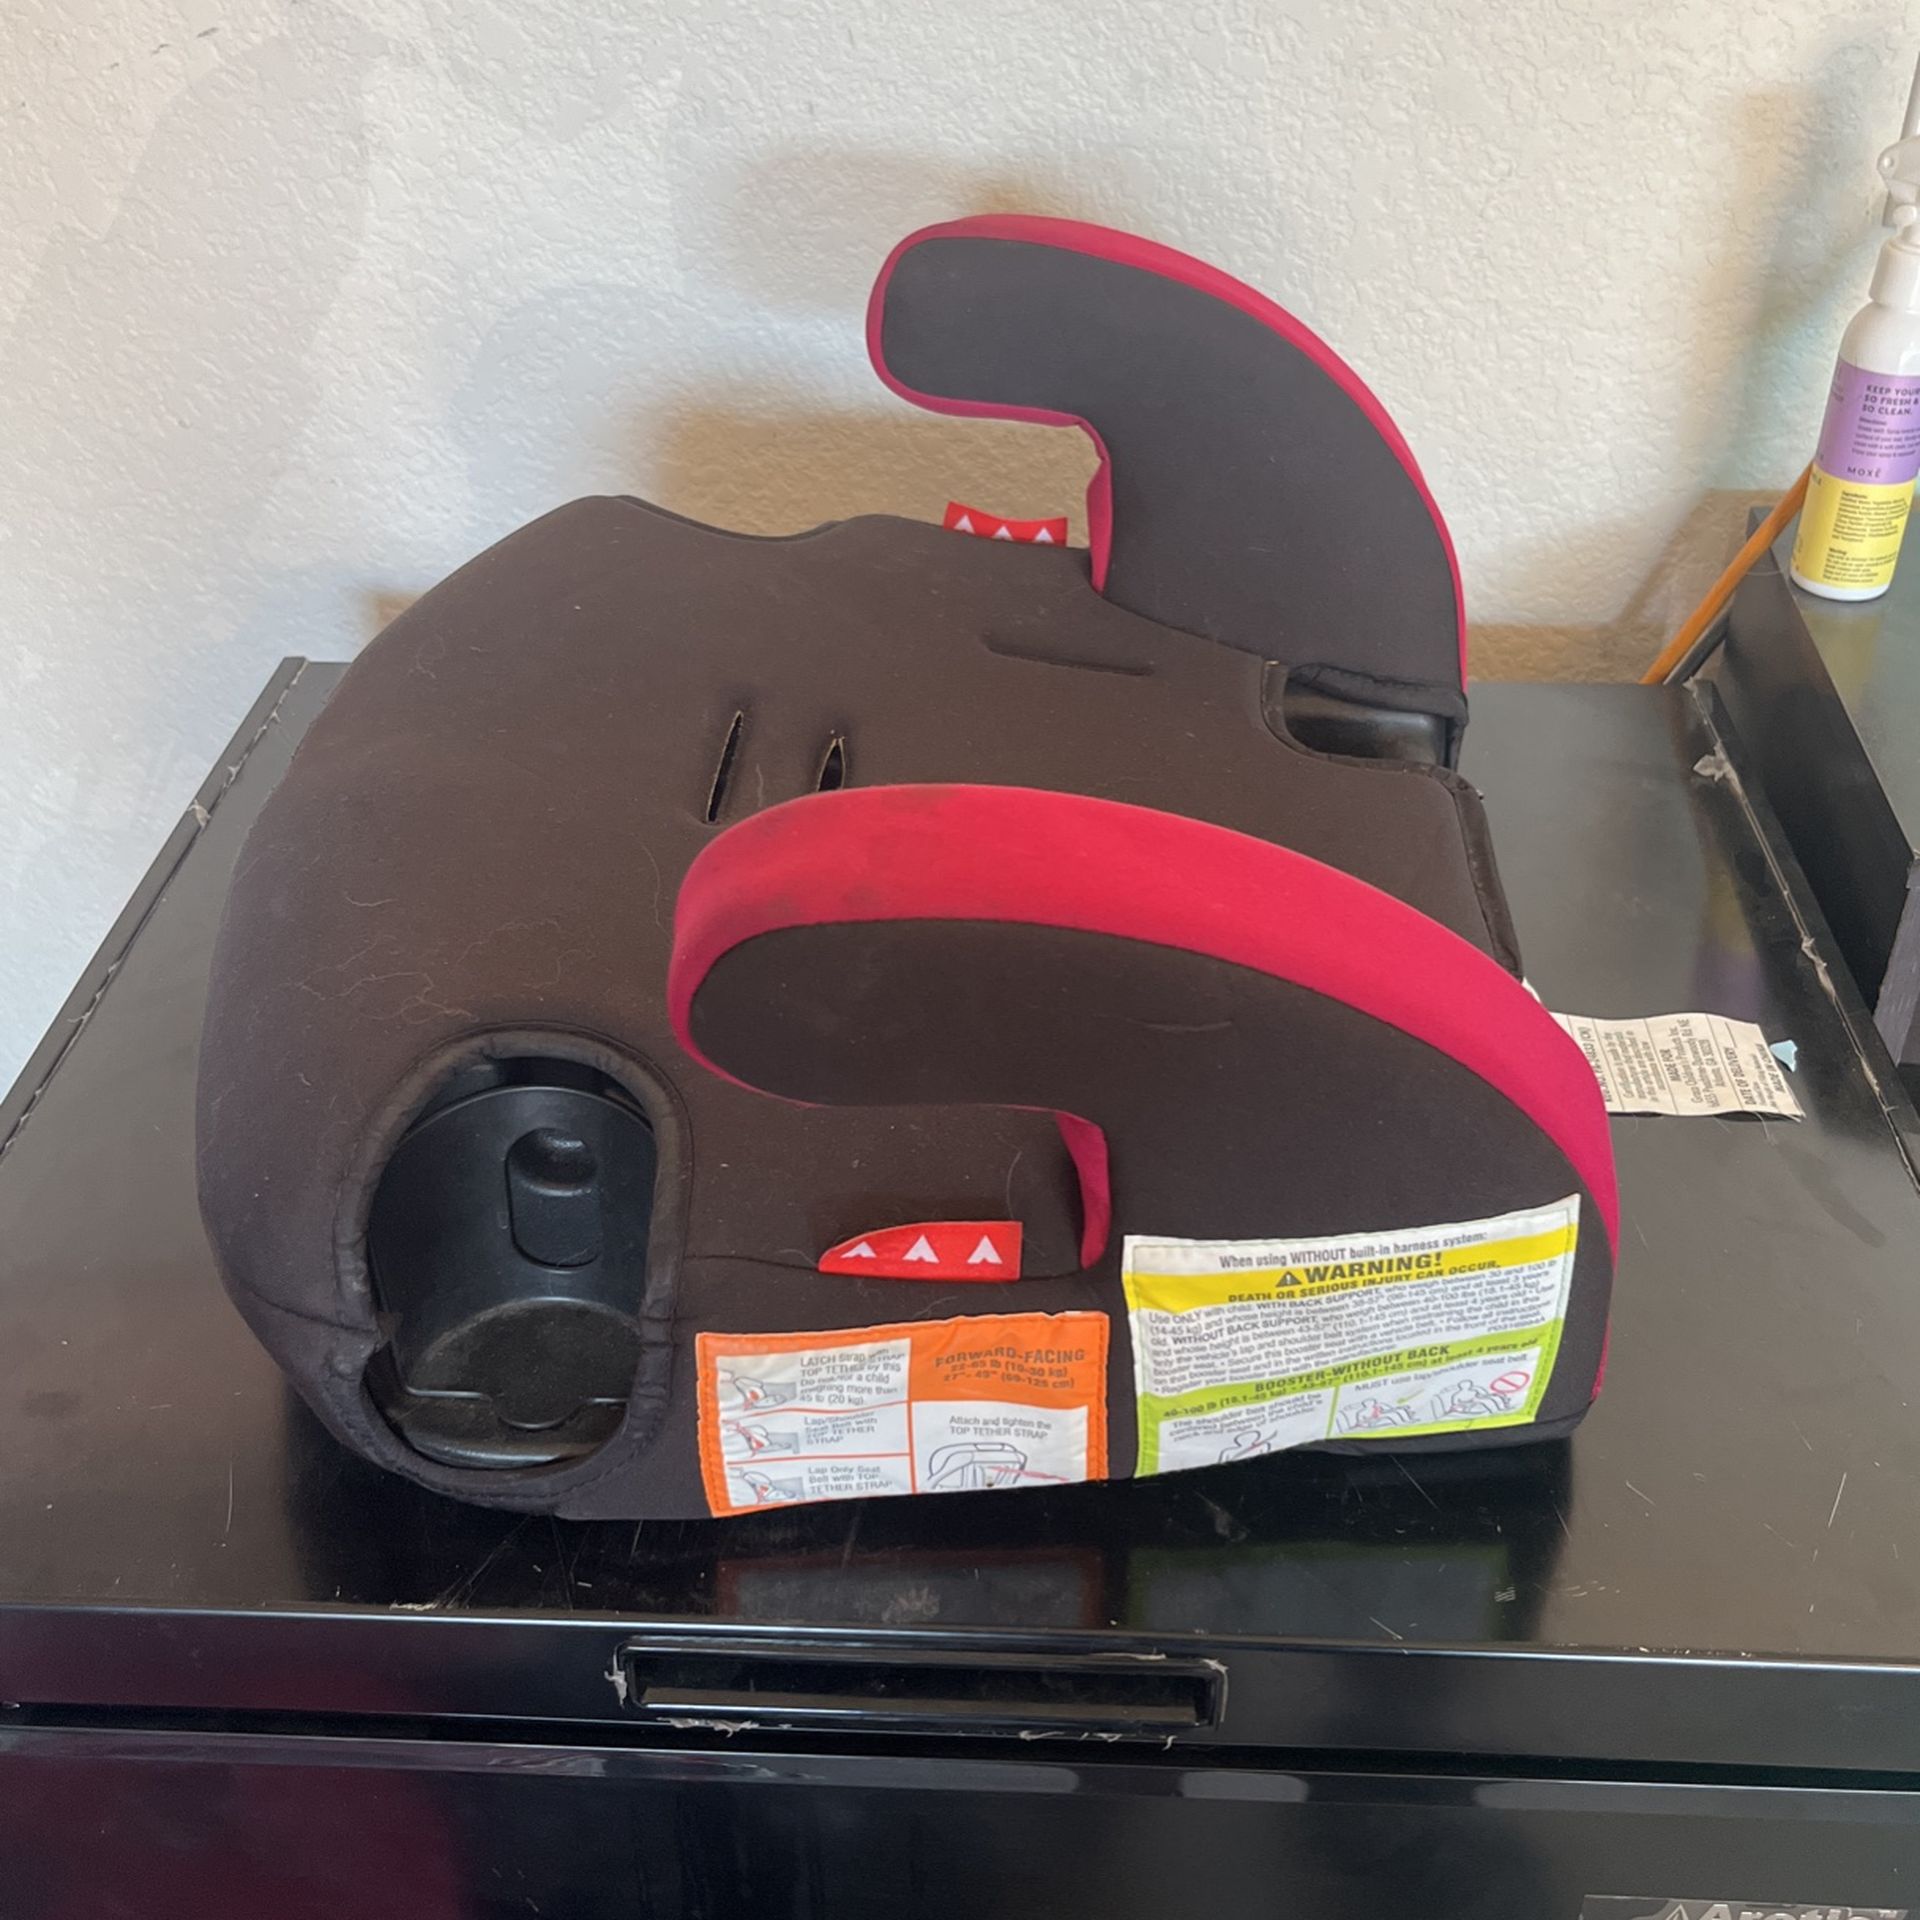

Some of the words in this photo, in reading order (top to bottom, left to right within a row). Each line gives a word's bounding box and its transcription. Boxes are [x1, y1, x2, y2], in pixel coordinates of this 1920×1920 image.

[1866, 384, 1891, 394] KEEP
[1865, 394, 1877, 404] SO
[1880, 397, 1911, 406] FRESH
[1862, 404, 1875, 413] SO
[1878, 407, 1913, 415] CLEAN.
[1659, 1049, 1674, 1062] FOR
[1724, 1047, 1744, 1078] DELIVERY
[1664, 1063, 1681, 1082] MADE
[1735, 1079, 1749, 1088] OF
[1740, 1089, 1756, 1105] DATE
[1219, 1255, 1252, 1268] When
[1256, 1254, 1287, 1267] using
[1290, 1248, 1346, 1265] WITHOUT
[1349, 1244, 1390, 1259] built-in
[1393, 1240, 1439, 1253] harness
[1442, 1232, 1488, 1247] system:
[1304, 1252, 1442, 1283] WARNING!
[1228, 1293, 1271, 1302] DEATH
[1276, 1291, 1295, 1299] OR
[1299, 1281, 1358, 1297] SERIOUS
[1362, 1273, 1411, 1287] INJURY
[1416, 1270, 1444, 1280] CAN
[1449, 1260, 1501, 1275] OCCUR.
[1149, 1312, 1170, 1324] Use
[1173, 1311, 1201, 1324] ONLY
[1257, 1301, 1286, 1309] WITH
[1289, 1299, 1323, 1307] BACK
[1172, 1329, 1224, 1345] WITHOUT
[1227, 1321, 1260, 1335] BACK
[800, 1354, 836, 1367] LATCH
[839, 1352, 866, 1364] Strap
[935, 1346, 1085, 1368] FORWARD-FACING
[800, 1368, 823, 1377] TOP
[883, 1363, 902, 1372] this
[1048, 1367, 1068, 1378] kg)
[1255, 1352, 1402, 1392] BOOSTER-WITHOUT
[1406, 1345, 1451, 1359] BACK
[1354, 1379, 1388, 1391] MUST
[1482, 1357, 1505, 1367] seat
[1507, 1353, 1529, 1363] belt
[800, 1378, 816, 1387] Do
[856, 1374, 864, 1382] a
[865, 1372, 890, 1385] child
[1051, 1377, 1076, 1389] cm)
[846, 1385, 873, 1394] more
[827, 1393, 846, 1405] (20
[848, 1396, 865, 1406] kg)
[949, 1415, 980, 1425] Attach
[982, 1417, 1001, 1427] and
[1002, 1417, 1034, 1428] tighten
[1036, 1420, 1053, 1430] the
[832, 1426, 876, 1436] TETHER
[950, 1426, 971, 1436] TOP
[973, 1427, 1012, 1437] TETHER
[1014, 1428, 1049, 1439] STRAP
[809, 1467, 828, 1475] Lap
[830, 1466, 854, 1475] Only
[857, 1466, 881, 1474] Seat
[809, 1476, 830, 1485] Belt
[832, 1474, 855, 1483] with
[857, 1473, 880, 1481] TOP
[810, 1483, 854, 1495] TETHER
[856, 1481, 894, 1491] STRAP
